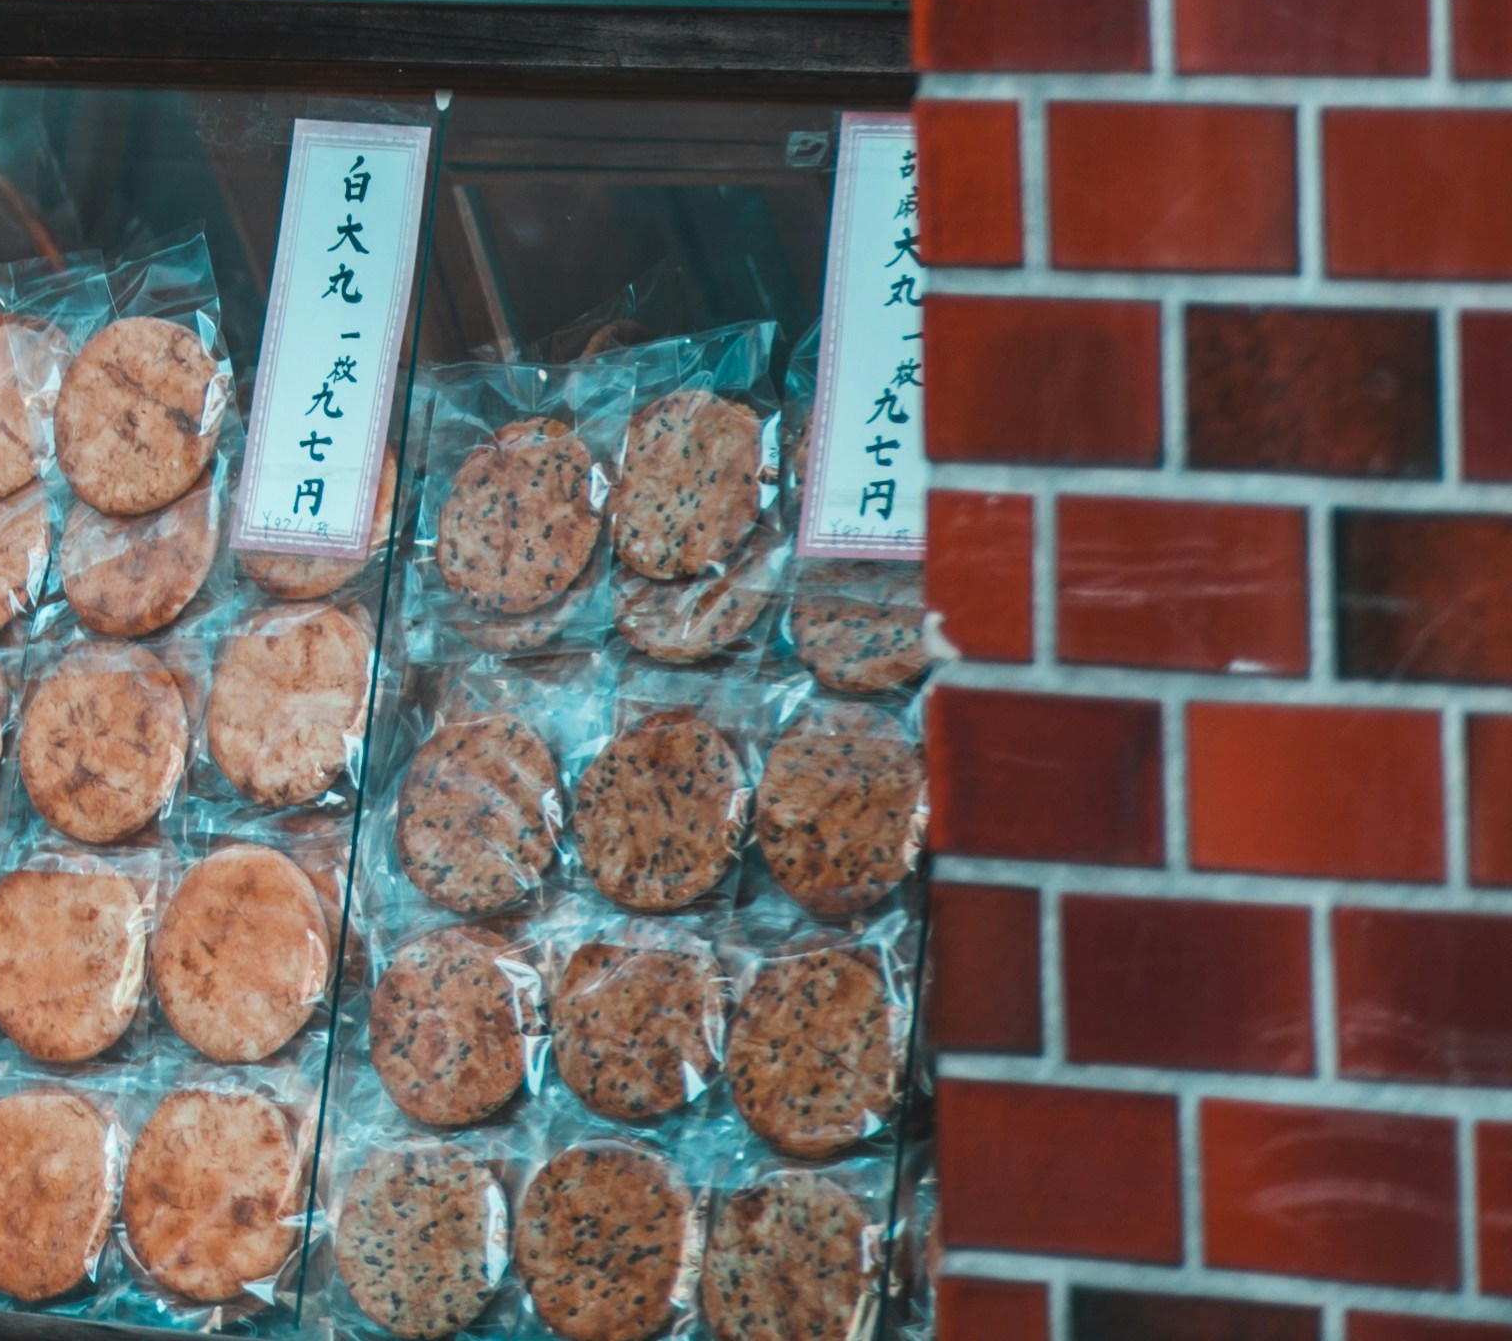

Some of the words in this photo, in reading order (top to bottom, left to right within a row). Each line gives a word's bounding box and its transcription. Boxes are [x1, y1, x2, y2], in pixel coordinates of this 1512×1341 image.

[320, 155, 372, 304] 白大丸
[326, 330, 360, 384] 一枚
[292, 381, 344, 517] 九七円
[859, 387, 910, 521] 九七円
